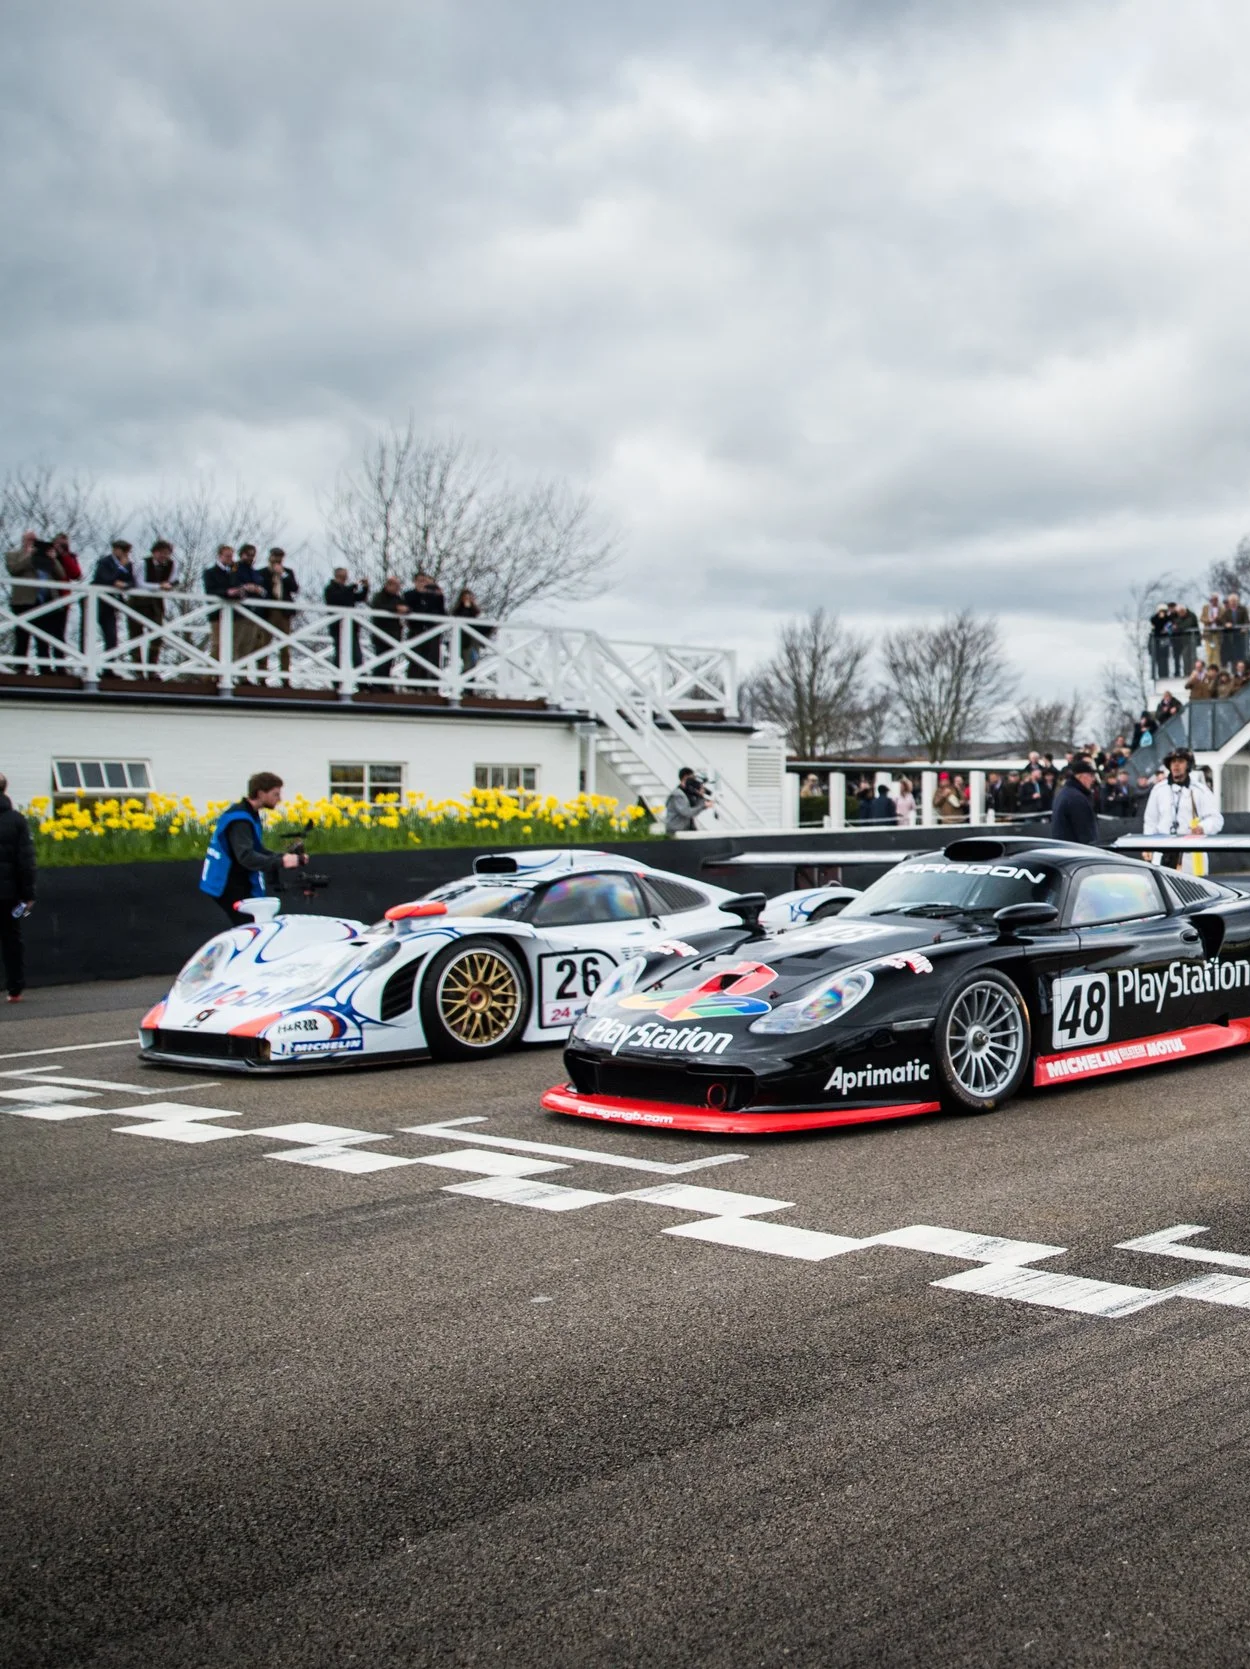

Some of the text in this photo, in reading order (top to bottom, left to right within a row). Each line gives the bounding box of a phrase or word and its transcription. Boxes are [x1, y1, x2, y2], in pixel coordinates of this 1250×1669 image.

[556, 956, 602, 1000] 26
[1117, 957, 1250, 1014] PlayStation
[1058, 981, 1107, 1040] 48
[293, 1040, 361, 1052] MICHELIN
[586, 1017, 733, 1056] PlayStation
[823, 1058, 930, 1096] Aprimatic
[1046, 1049, 1123, 1079] MICHELIN
[1146, 1037, 1186, 1058] MOTUL
[577, 1105, 674, 1125] paragongb.com
